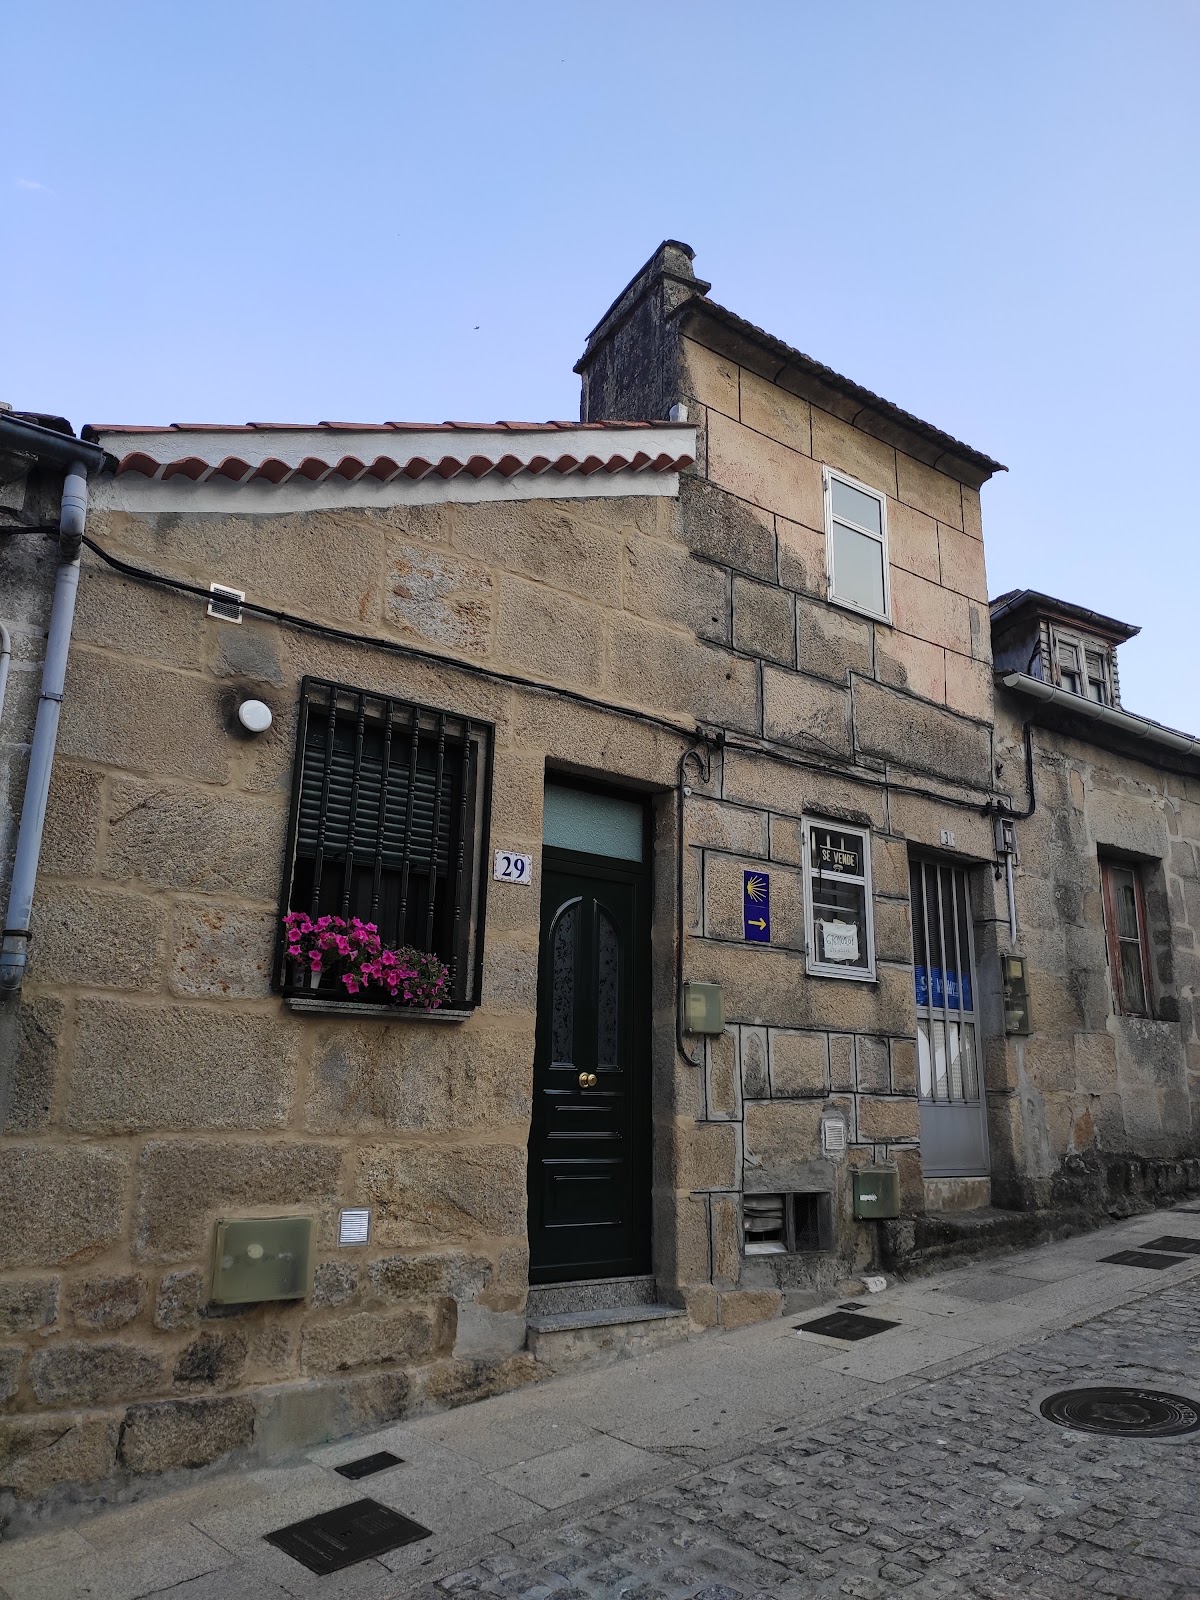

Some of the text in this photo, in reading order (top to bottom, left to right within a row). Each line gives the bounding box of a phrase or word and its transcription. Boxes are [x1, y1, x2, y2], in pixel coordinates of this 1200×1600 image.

[501, 856, 525, 879] 29
[821, 849, 855, 867] SE VENDE
